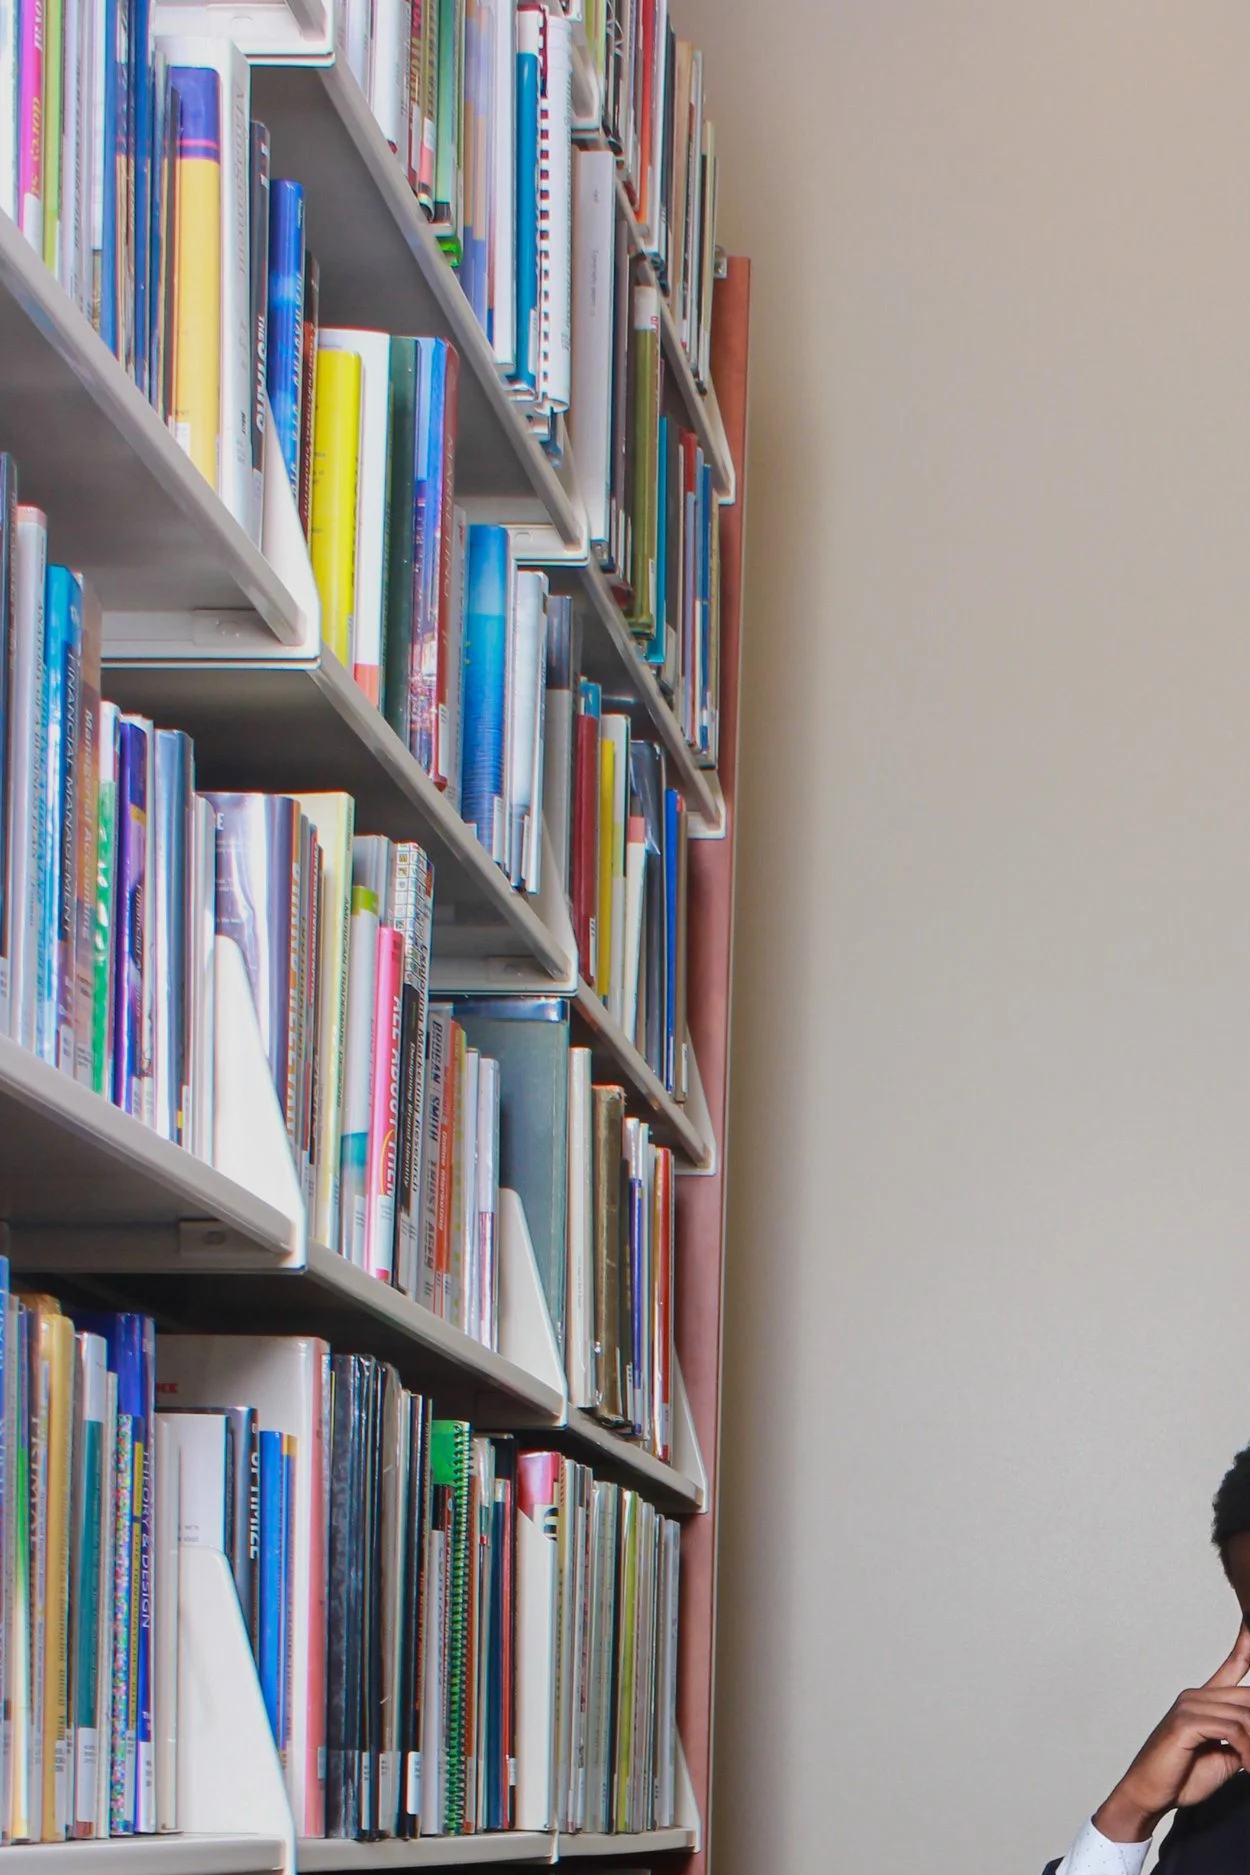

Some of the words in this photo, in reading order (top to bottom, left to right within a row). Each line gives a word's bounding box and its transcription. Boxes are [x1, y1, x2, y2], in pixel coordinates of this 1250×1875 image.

[65, 652, 76, 771] FINANCIAL
[83, 709, 94, 821] Managerial
[63, 775, 76, 933] MANAGEMENT
[82, 827, 93, 941] Accounting
[338, 969, 348, 1044] TRADEMARK
[415, 945, 428, 1024] Exploring
[407, 1043, 415, 1101] Designing
[405, 1104, 413, 1140] Brand
[412, 1119, 422, 1193] Research
[429, 1095, 441, 1142] SMITH
[404, 1143, 412, 1188] Identity
[142, 1451, 150, 1526] THEORY
[141, 1554, 150, 1629] DESIGN
